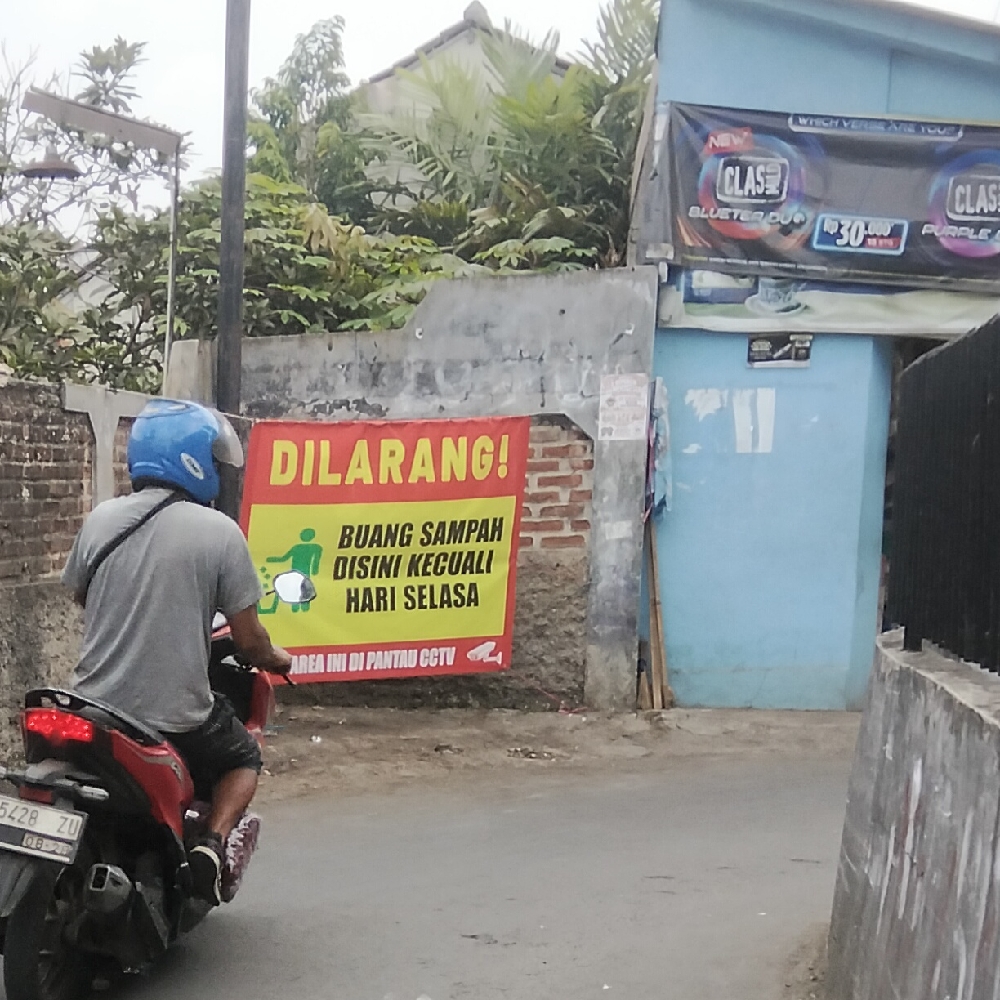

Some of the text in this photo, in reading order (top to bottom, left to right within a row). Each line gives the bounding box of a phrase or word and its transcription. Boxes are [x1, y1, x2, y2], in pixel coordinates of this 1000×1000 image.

[921, 223, 992, 240] PURPLE
[269, 434, 509, 486] DILARANG!
[337, 516, 504, 550] BUANG SAMPAH
[332, 549, 495, 581] DISINI KECUALI
[345, 582, 480, 614] HARI SELASA
[291, 646, 457, 675] AREA INI DI PANTAU CCTV
[56, 815, 80, 836] ZU
